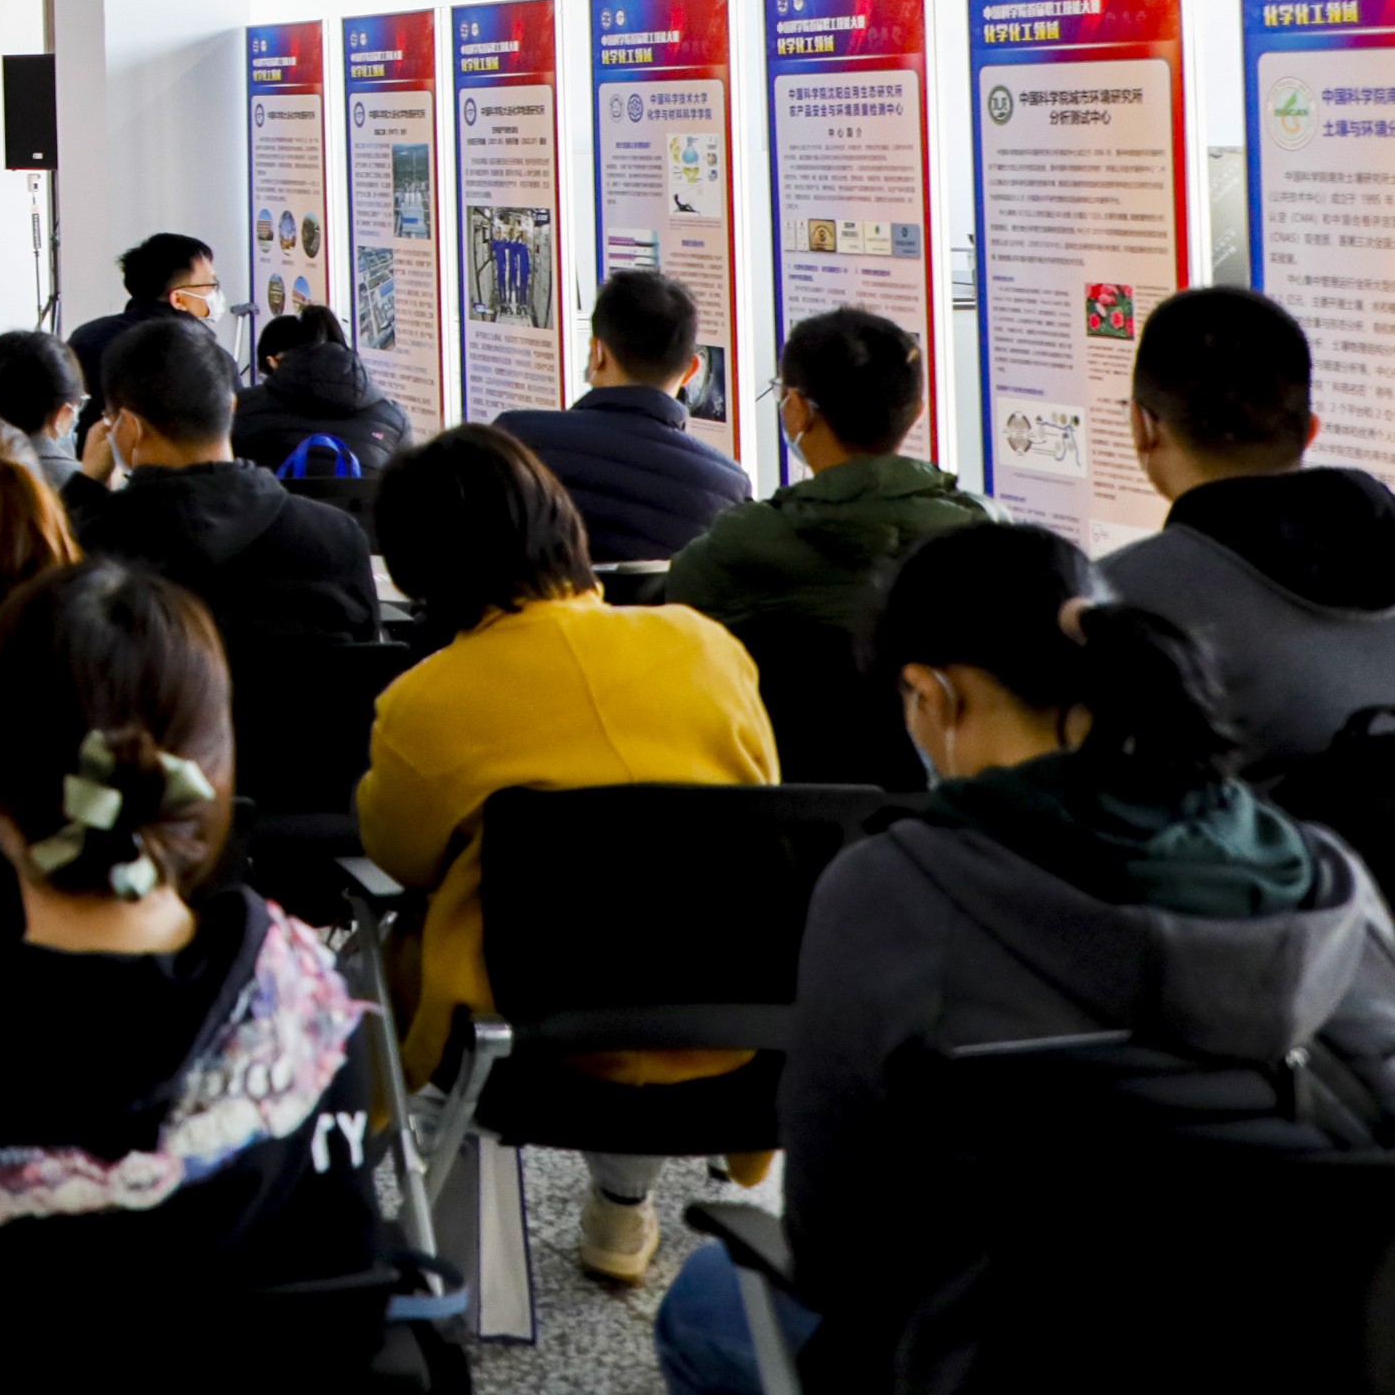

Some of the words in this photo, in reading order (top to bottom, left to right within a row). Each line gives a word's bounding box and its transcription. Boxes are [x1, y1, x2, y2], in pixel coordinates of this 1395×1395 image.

[1019, 88, 1143, 107] 中国科学院城市环境研究所
[1049, 109, 1112, 126] 分析测试中心
